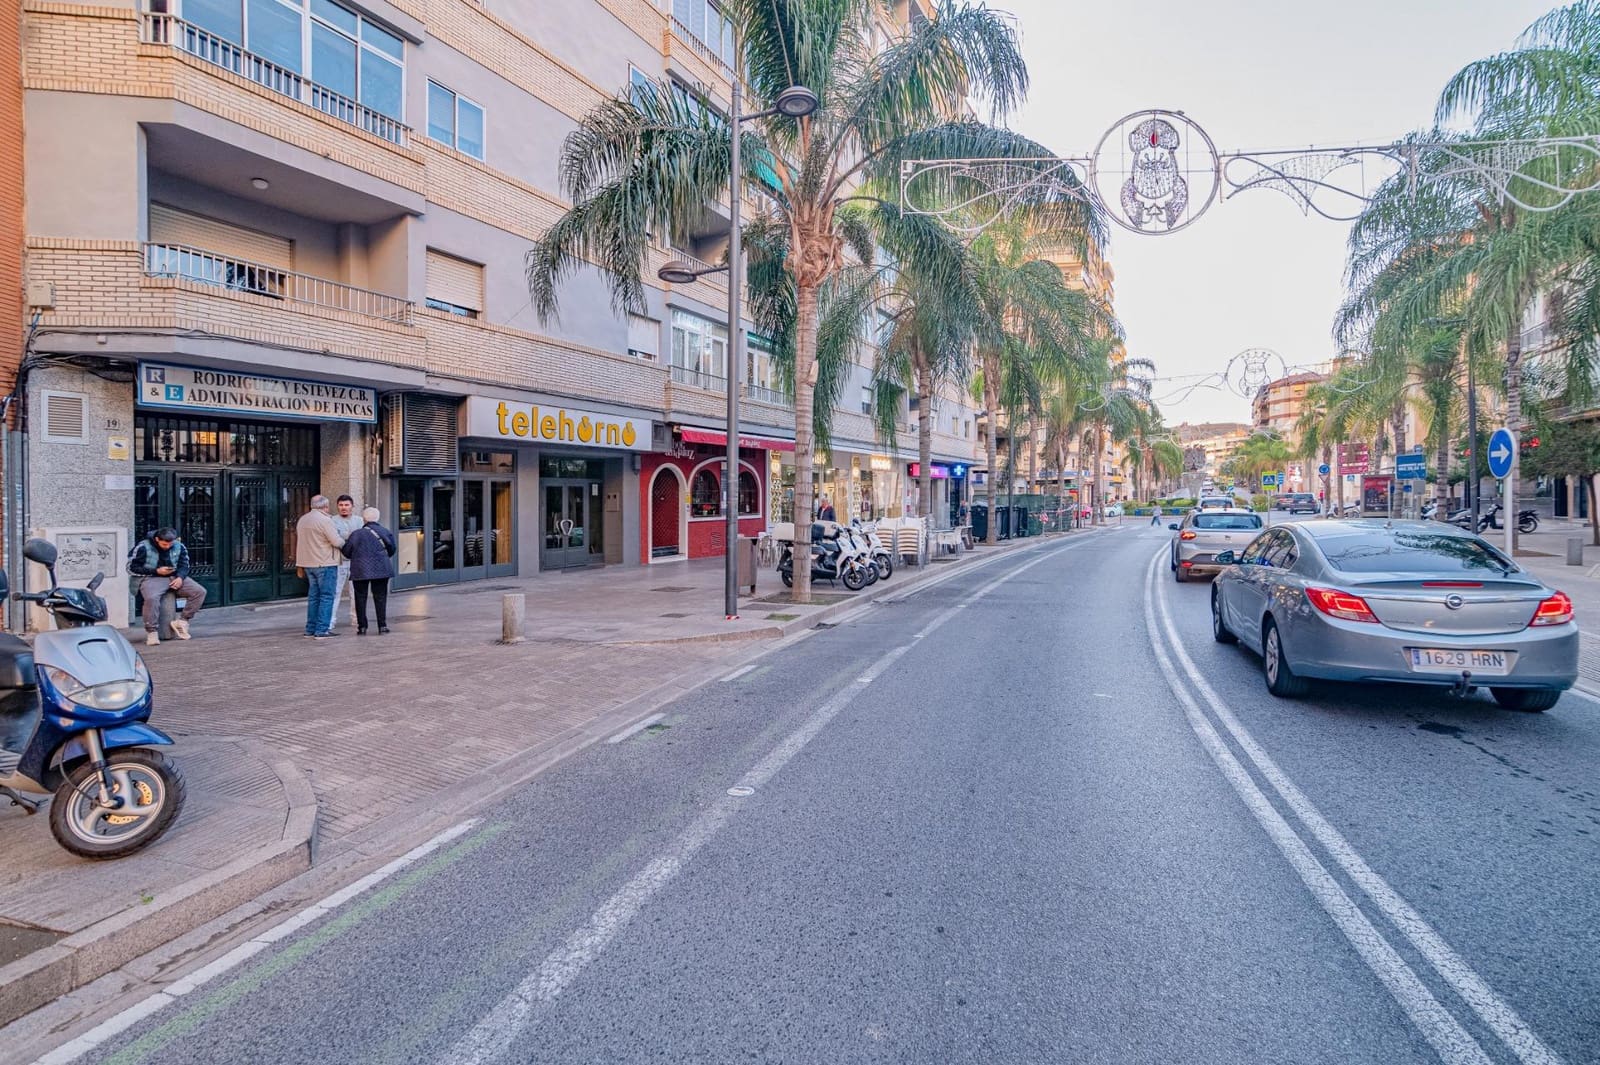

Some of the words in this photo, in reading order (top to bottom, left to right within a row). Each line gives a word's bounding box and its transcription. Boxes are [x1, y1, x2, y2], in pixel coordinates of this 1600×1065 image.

[150, 369, 163, 382] R
[150, 386, 160, 396] &
[169, 387, 181, 399] E
[193, 370, 279, 392] RODRIGUEZ
[281, 380, 291, 393] Y
[294, 382, 346, 399] ESTEVEZ
[349, 388, 369, 402] C.B.
[187, 388, 310, 411] ADMINISTRACION
[312, 400, 331, 413] DE
[334, 402, 373, 416] FINCAS
[106, 419, 118, 428] 19
[496, 401, 636, 446] telehorno
[1425, 651, 1465, 665] 1629
[1471, 653, 1503, 667] HRN
